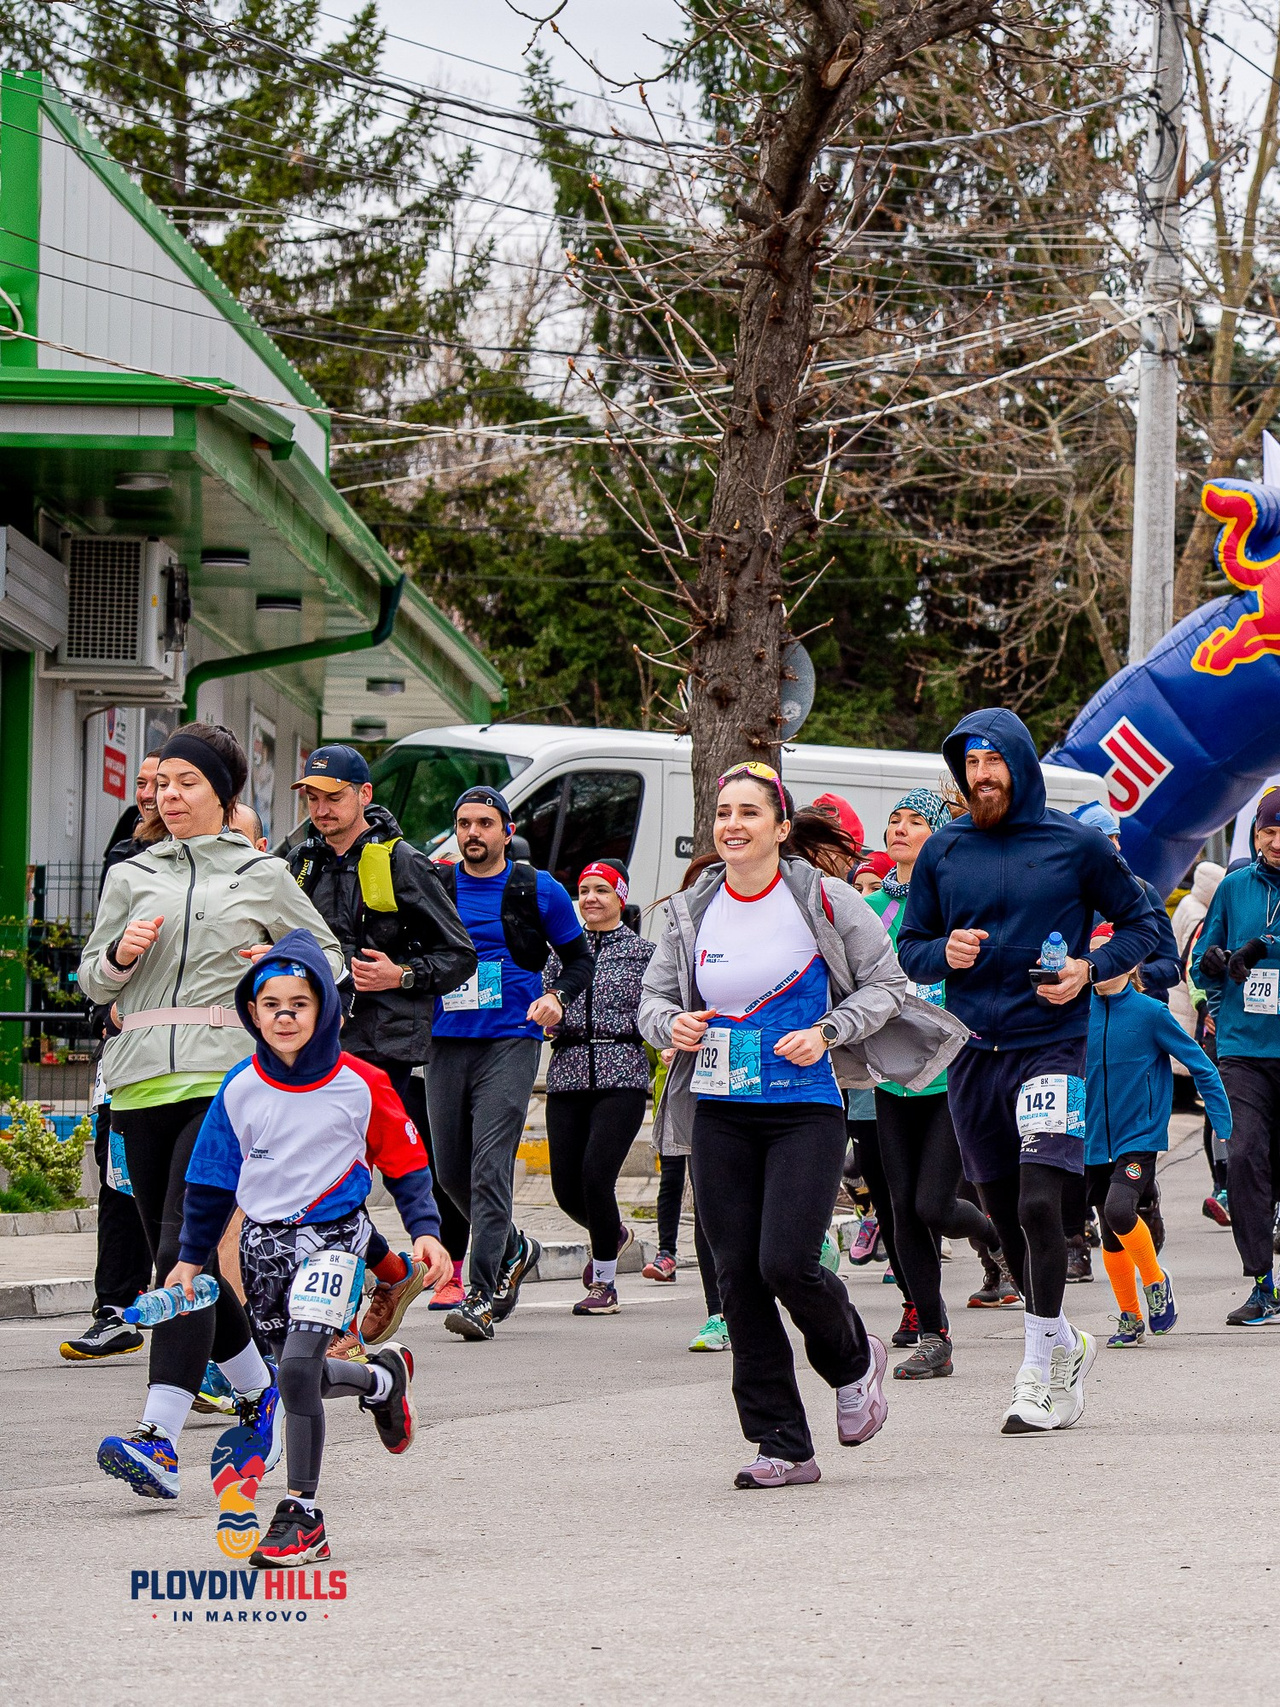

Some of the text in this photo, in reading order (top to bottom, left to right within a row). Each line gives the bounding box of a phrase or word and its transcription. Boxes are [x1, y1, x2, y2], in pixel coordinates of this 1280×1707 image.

[1103, 720, 1168, 814] ull
[772, 969, 800, 992] MATTERS
[1249, 982, 1271, 997] 278
[701, 1047, 718, 1068] 132
[1025, 1091, 1056, 1112] 142
[329, 1254, 340, 1263] 8K
[304, 1271, 343, 1297] 218
[320, 1297, 332, 1305] RUN
